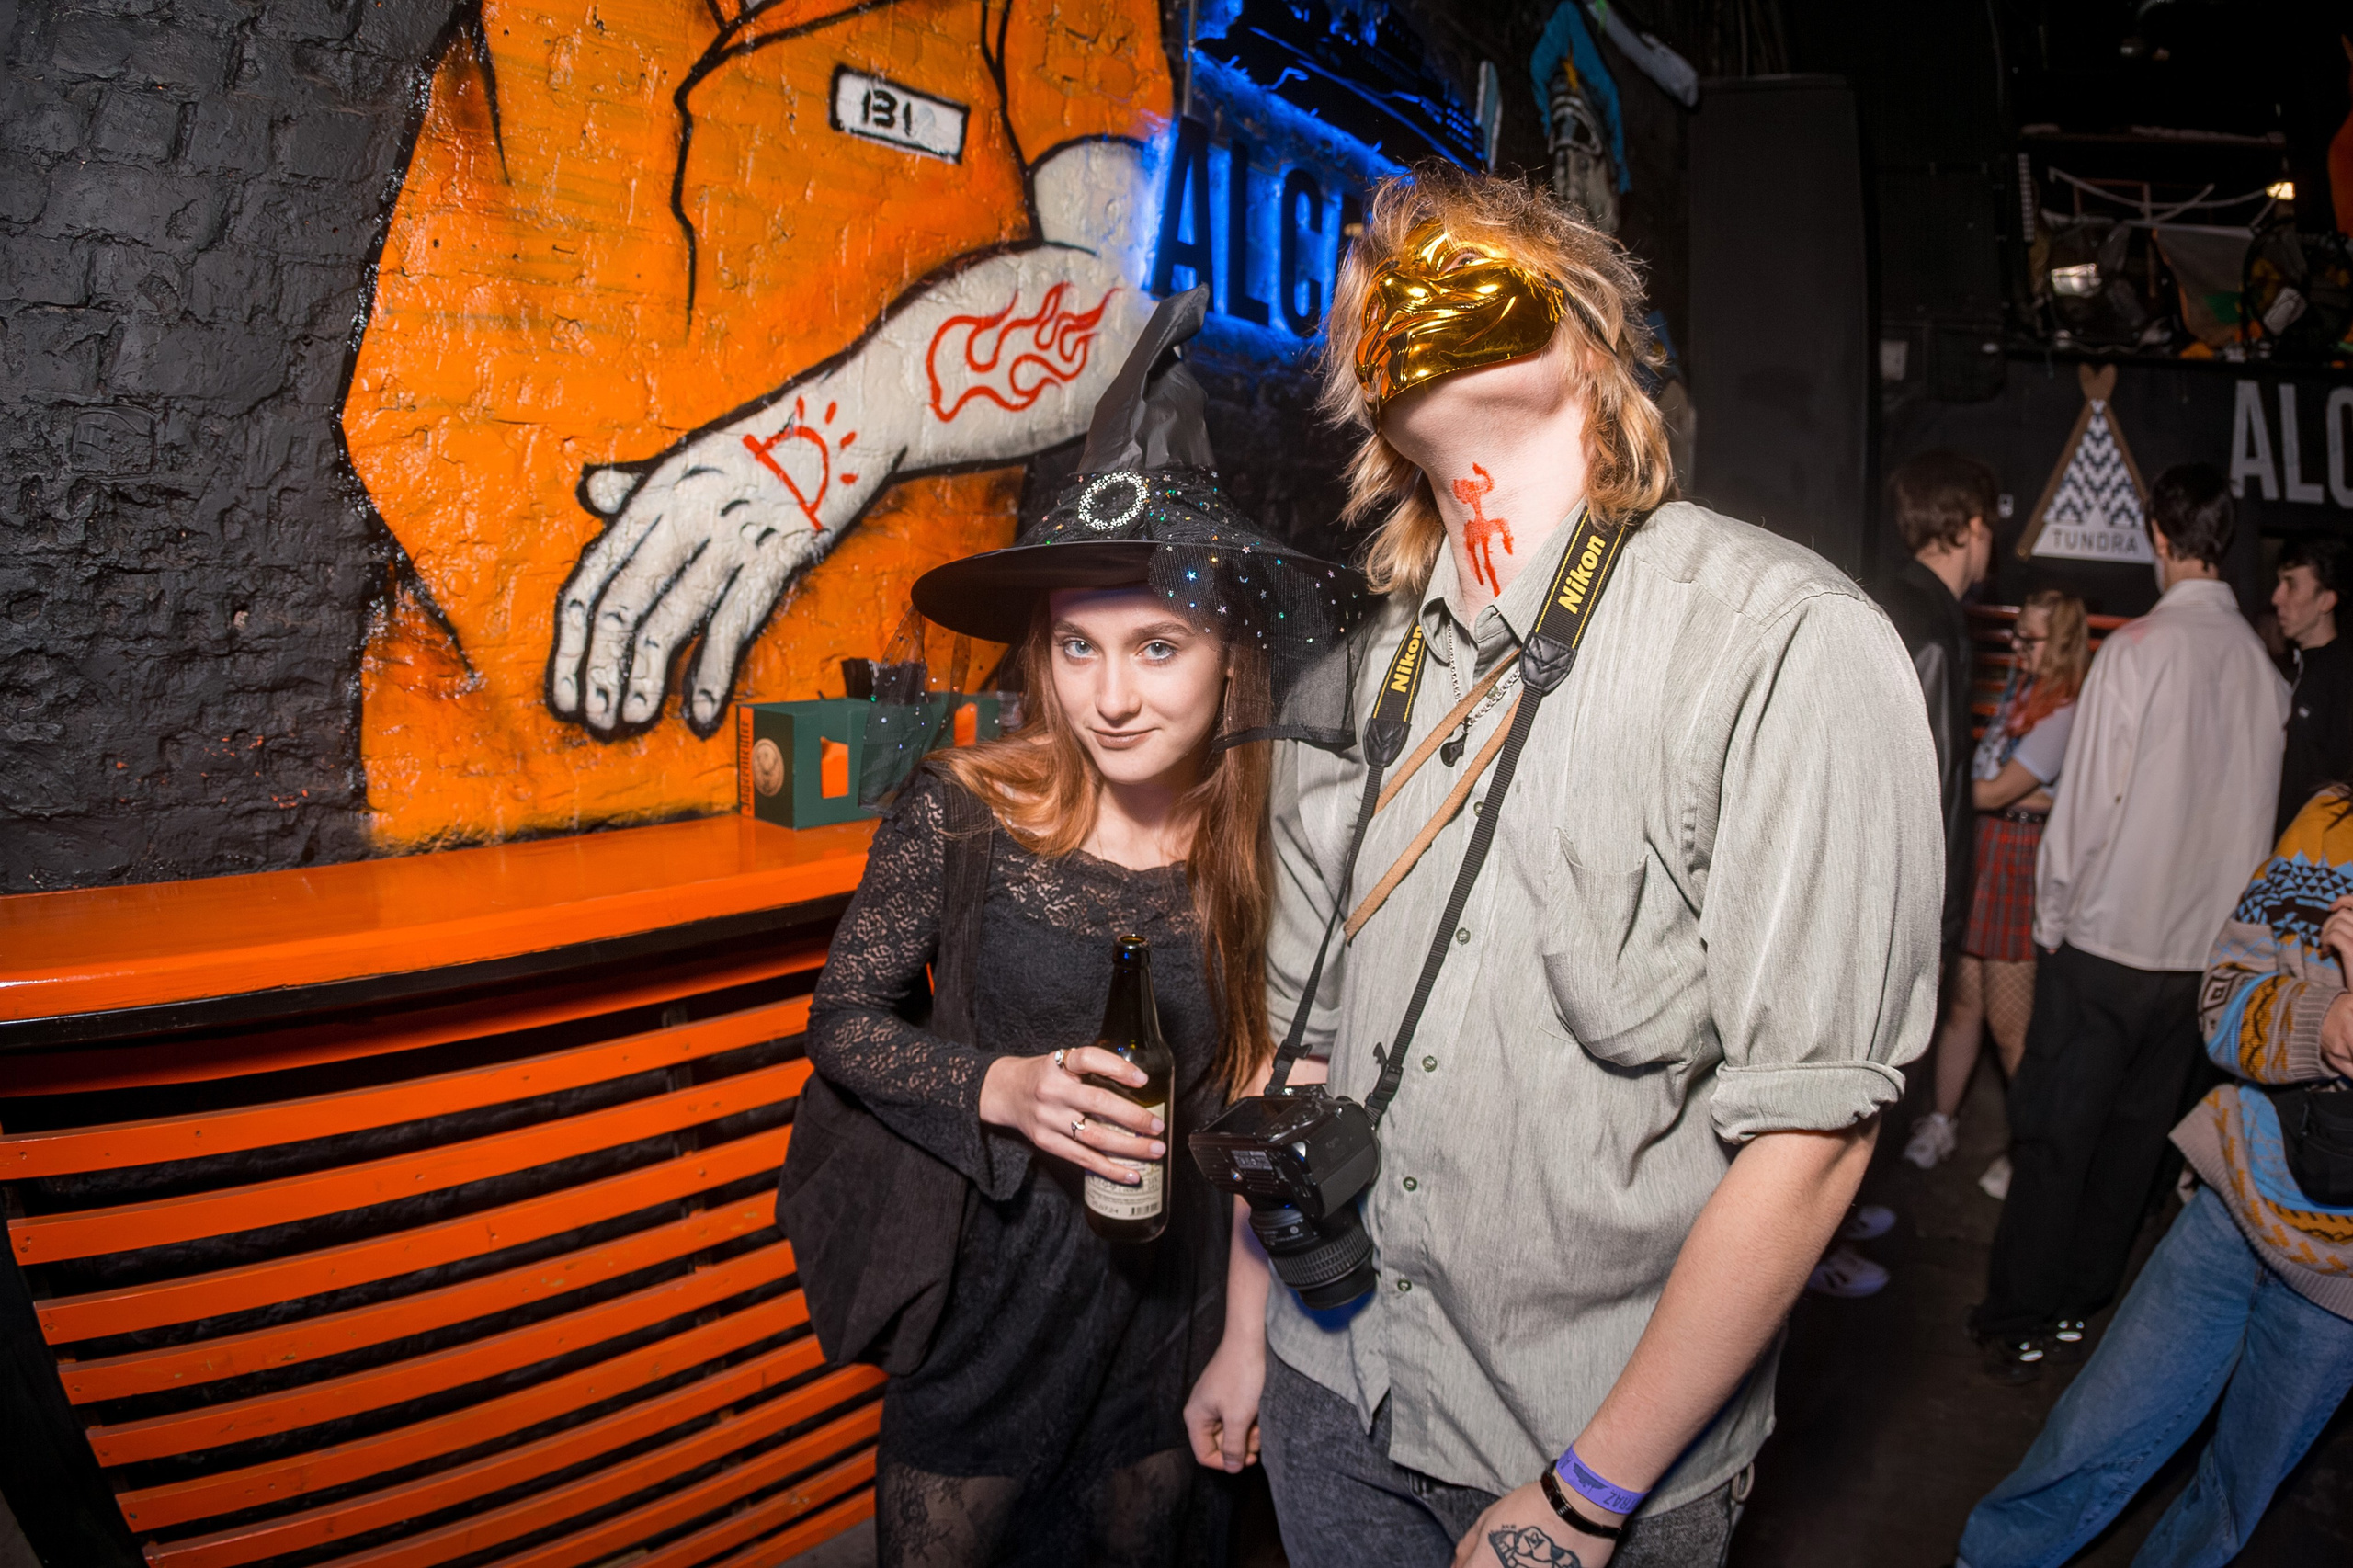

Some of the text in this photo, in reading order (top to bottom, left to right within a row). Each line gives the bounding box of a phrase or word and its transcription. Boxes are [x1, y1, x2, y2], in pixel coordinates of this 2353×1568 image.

[1557, 533, 1607, 615] Nikon
[2052, 529, 2139, 552] TUNDRA
[1390, 624, 1423, 694] Nikon
